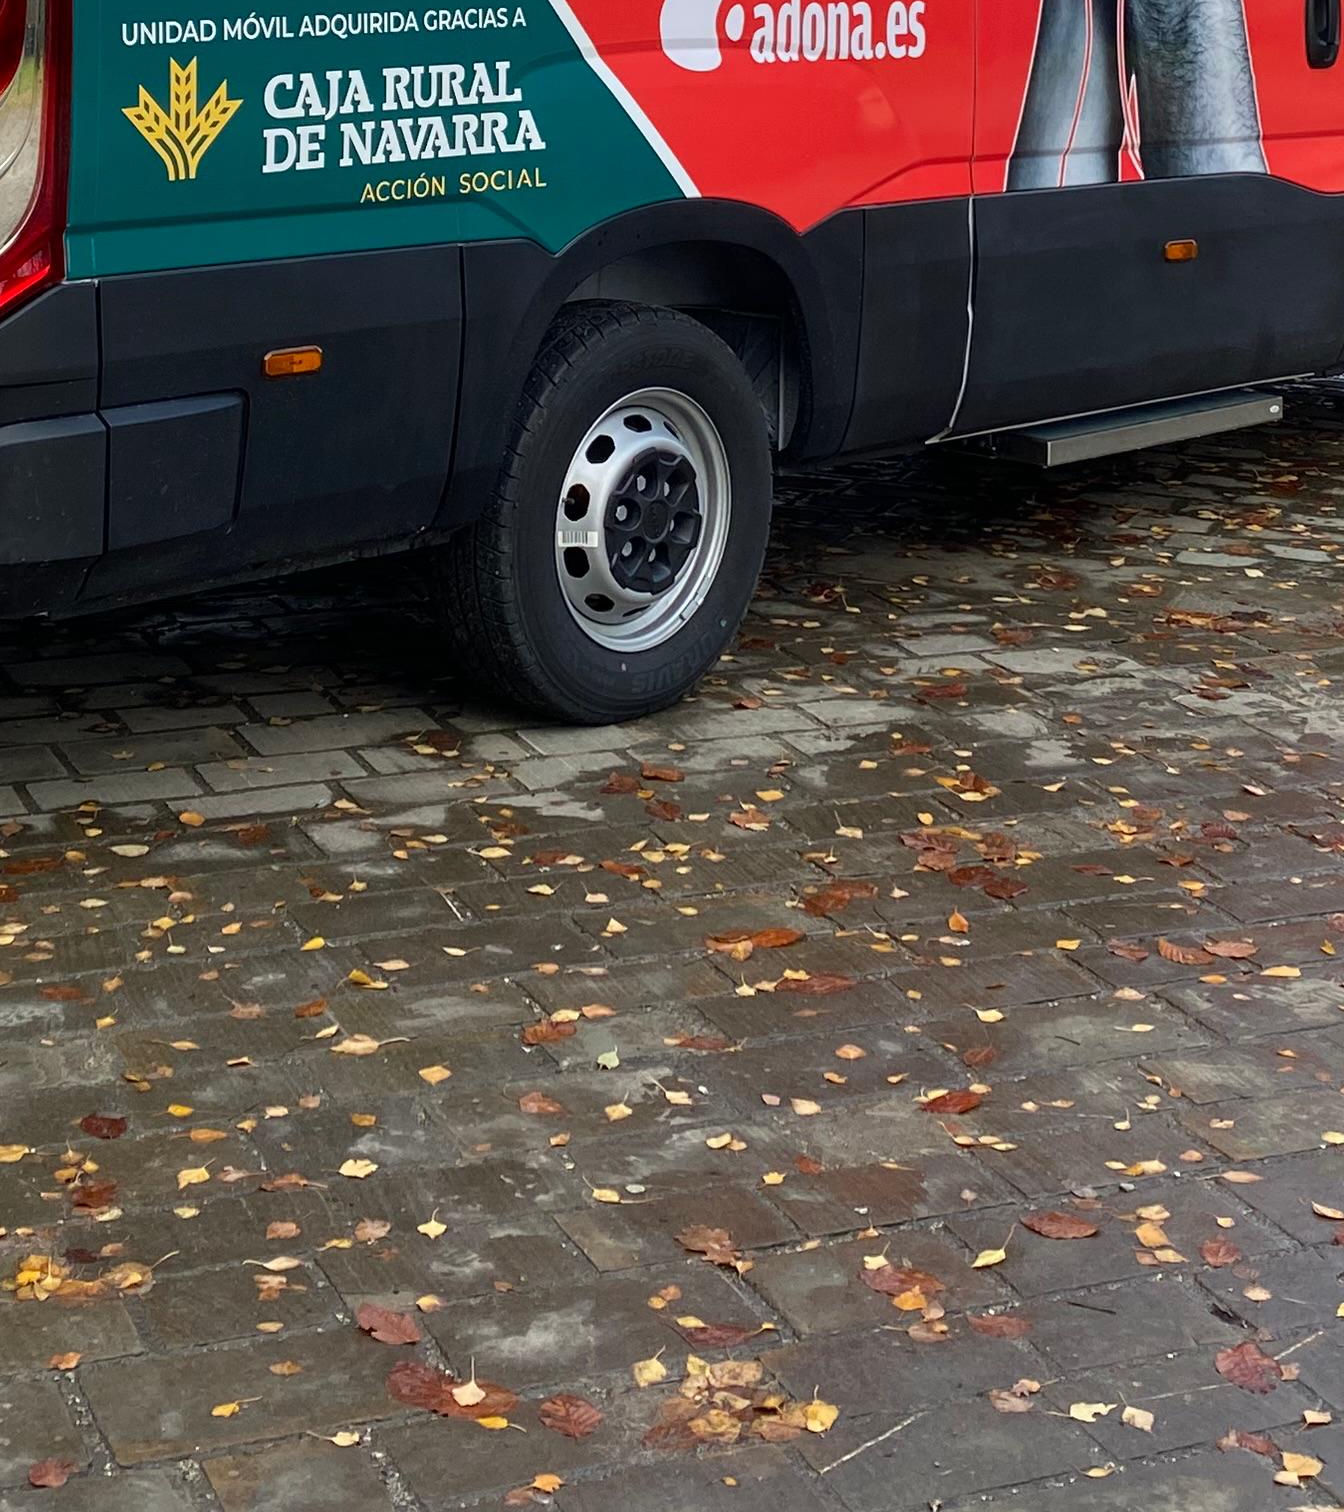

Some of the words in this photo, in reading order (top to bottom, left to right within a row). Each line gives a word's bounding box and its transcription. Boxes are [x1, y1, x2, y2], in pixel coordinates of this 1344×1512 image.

[121, 19, 218, 46] UNIDAD
[223, 11, 294, 41] MÓVIL
[298, 9, 419, 41] ADQUIRIDA
[423, 7, 507, 30] GRACIAS
[511, 6, 527, 28] A
[262, 69, 374, 122] CAJA
[382, 60, 523, 108] RURAL
[261, 126, 326, 175] DE
[338, 109, 546, 168] NAVARRA
[360, 171, 447, 204] ACCIÓN
[459, 166, 547, 195] SOCIAL
